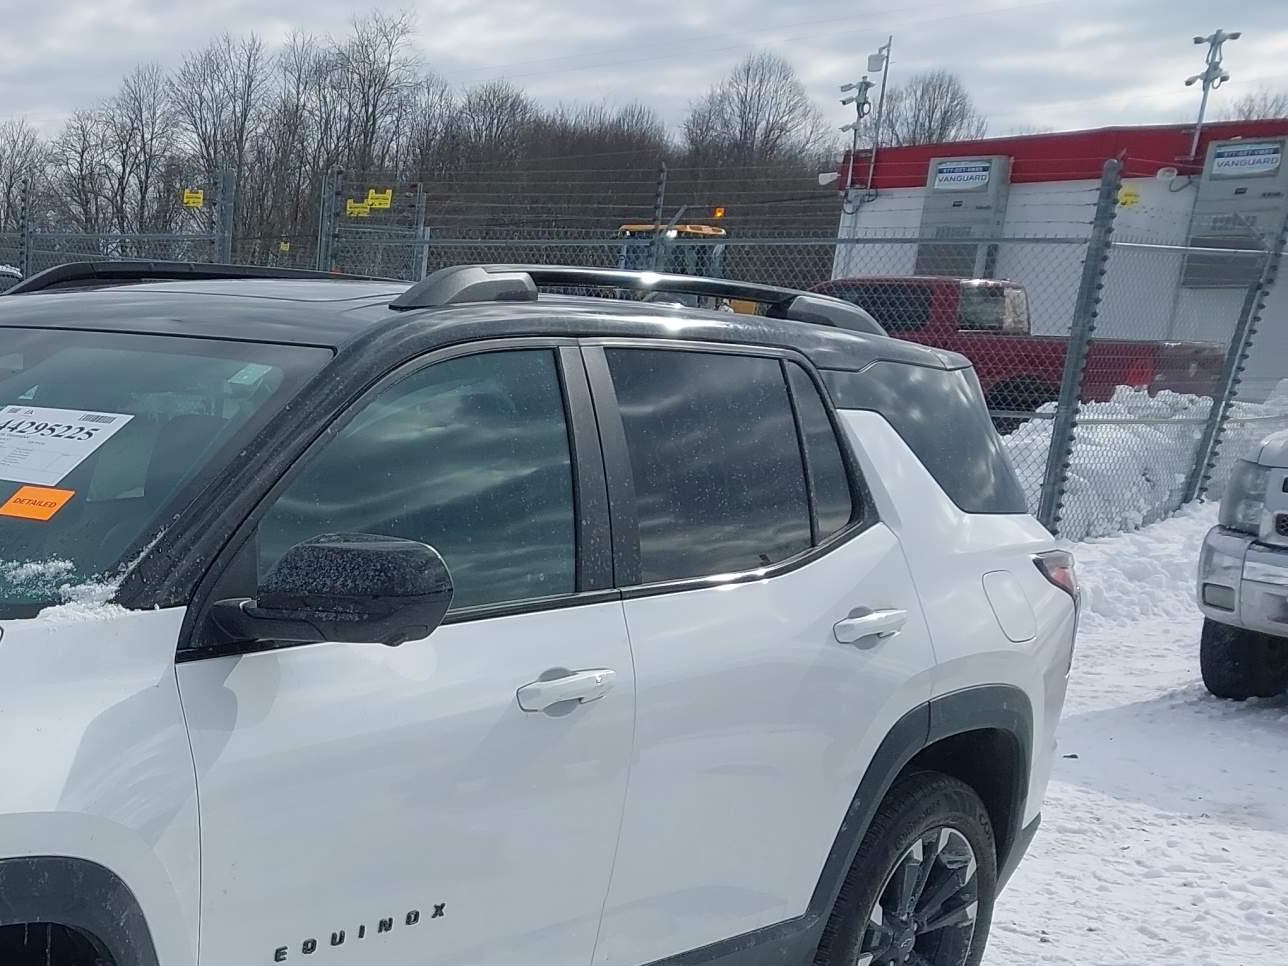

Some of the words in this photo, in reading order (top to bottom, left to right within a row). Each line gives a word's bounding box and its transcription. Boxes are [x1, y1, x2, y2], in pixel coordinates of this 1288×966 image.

[1216, 157, 1279, 169] VANGUARD
[938, 174, 987, 183] VANGUARD
[13, 497, 57, 509] DETAILED
[272, 901, 447, 964] EQUINOX
